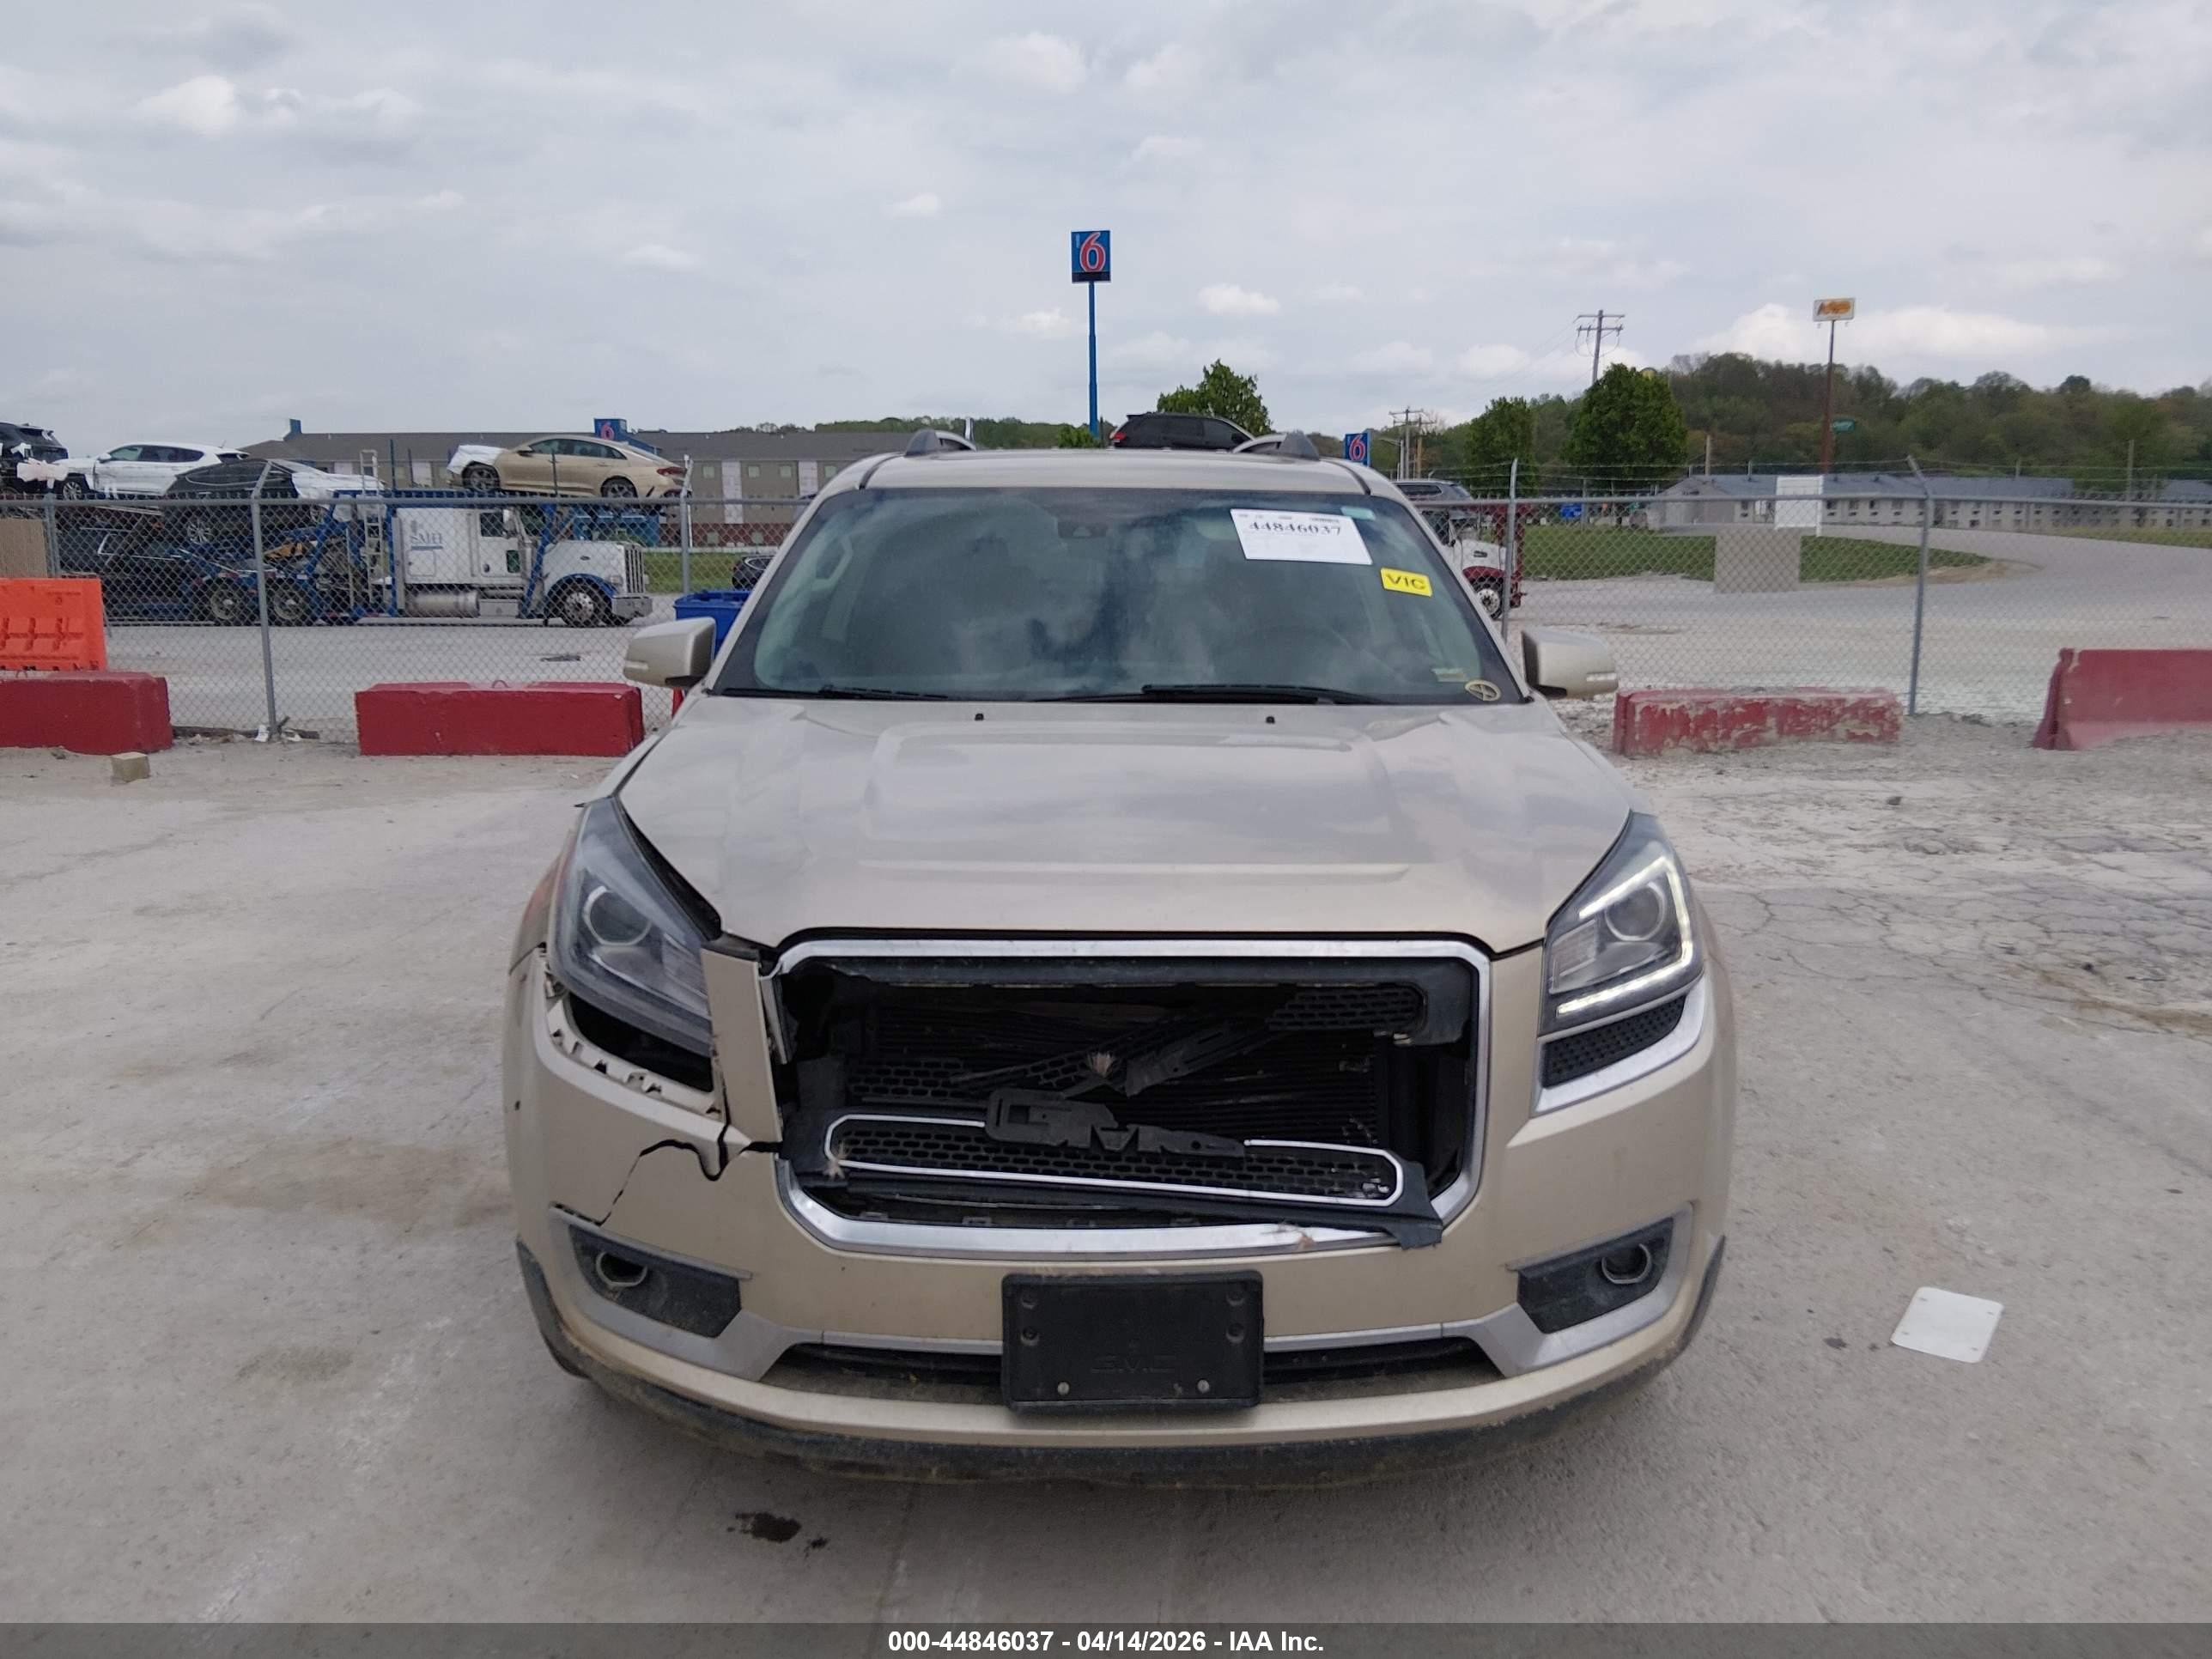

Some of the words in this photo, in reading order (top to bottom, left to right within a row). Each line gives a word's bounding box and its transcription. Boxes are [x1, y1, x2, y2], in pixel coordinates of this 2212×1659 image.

[1079, 232, 1106, 272] 6
[600, 421, 615, 441] 6
[1349, 434, 1366, 461] 6
[1249, 520, 1341, 537] 44846037
